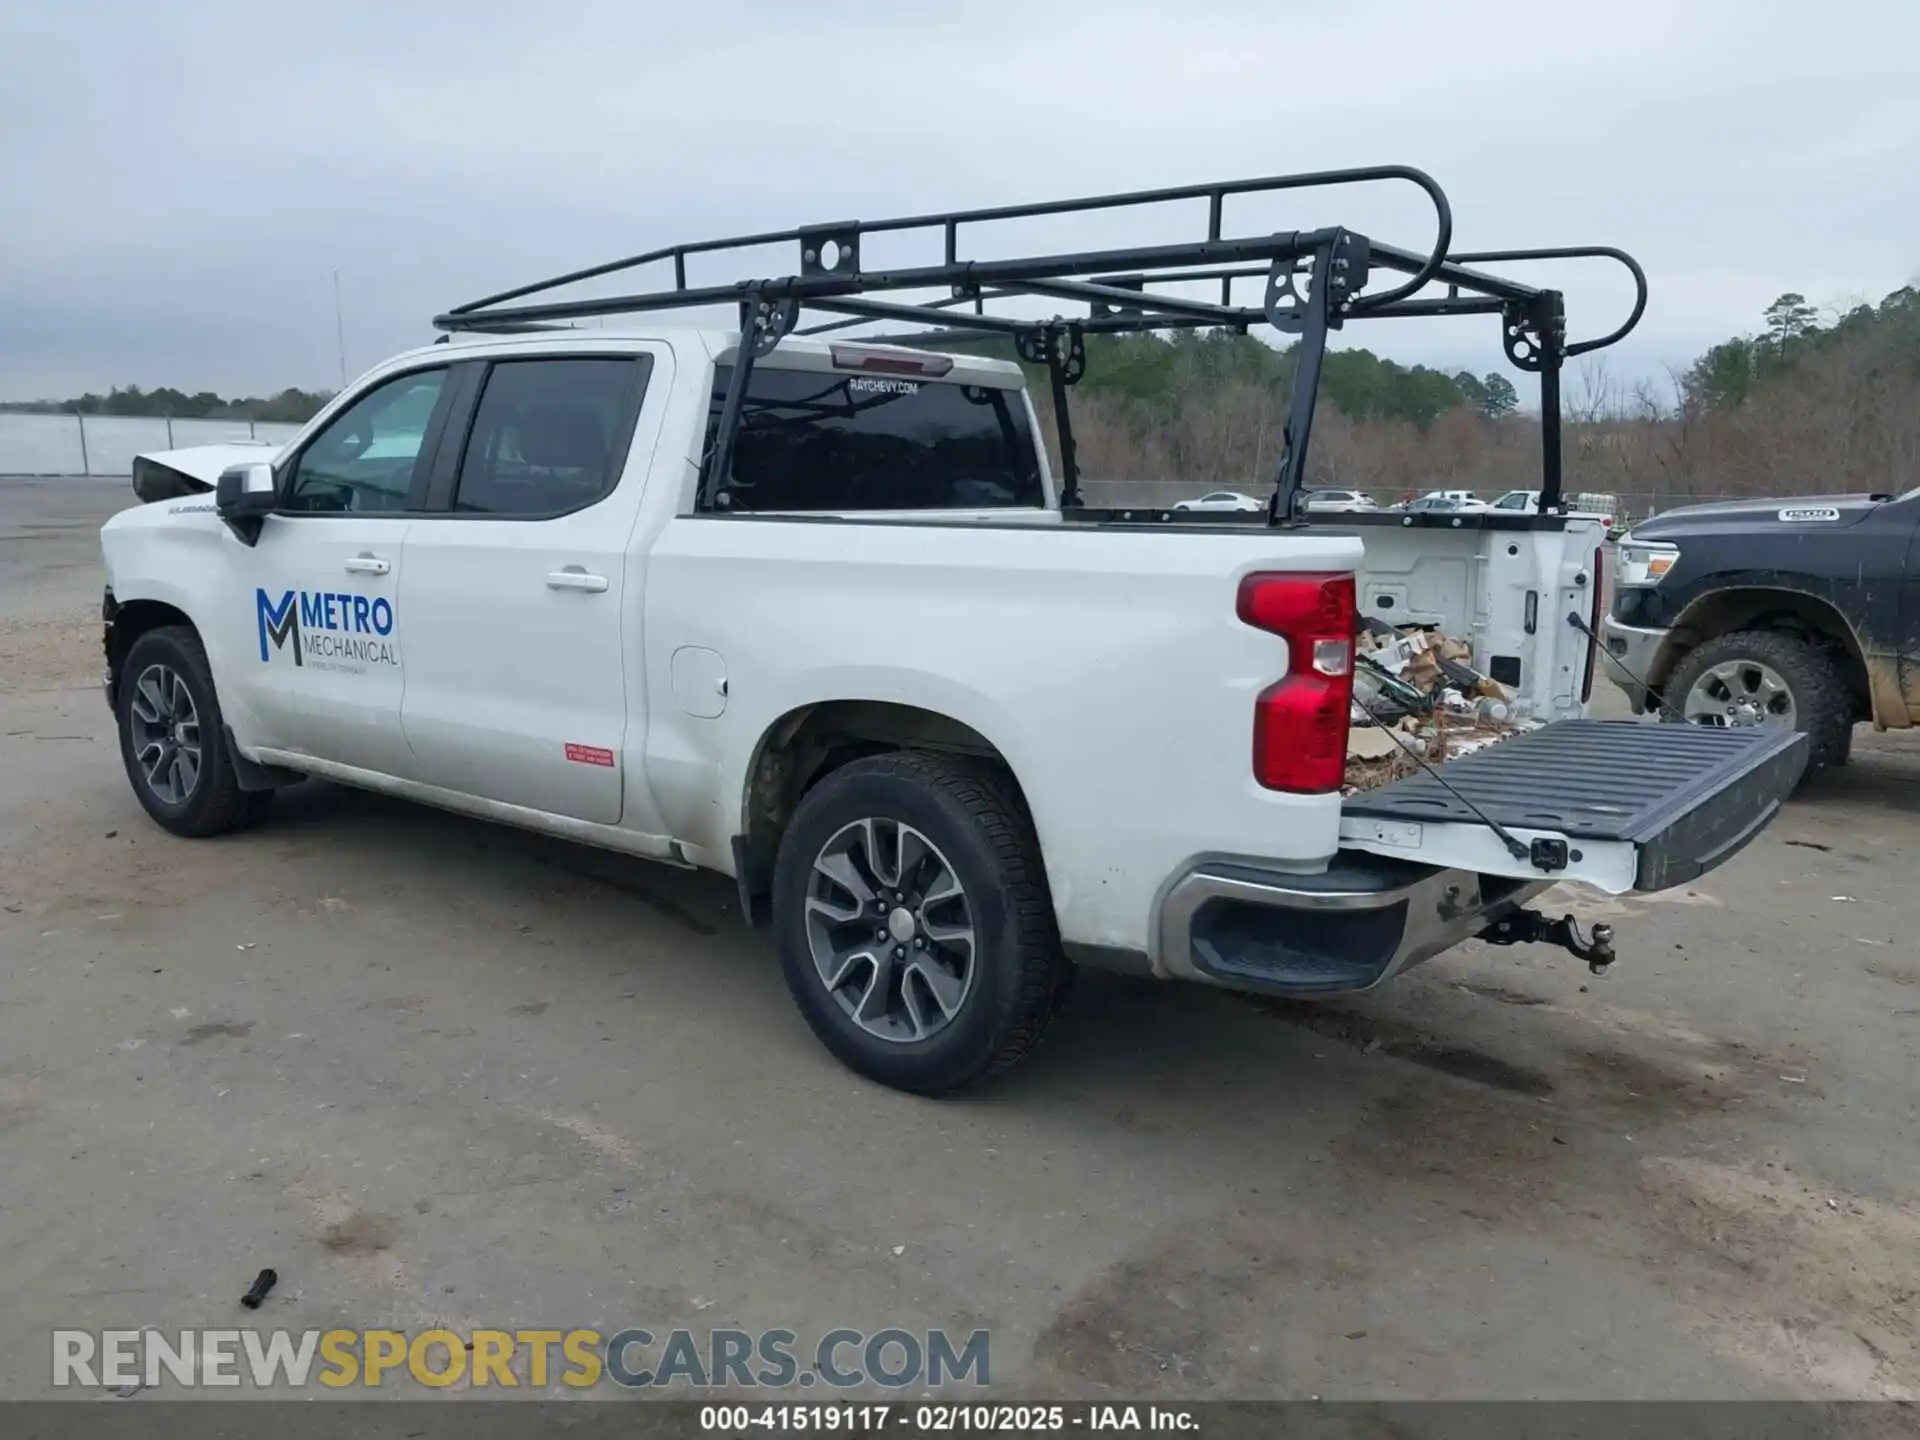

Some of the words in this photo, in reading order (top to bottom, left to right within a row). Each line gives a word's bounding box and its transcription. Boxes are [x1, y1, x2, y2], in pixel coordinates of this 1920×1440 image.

[849, 378, 918, 395] RAYCHEVY.COM
[301, 591, 393, 637] METRO
[303, 634, 400, 666] MECHANICAL
